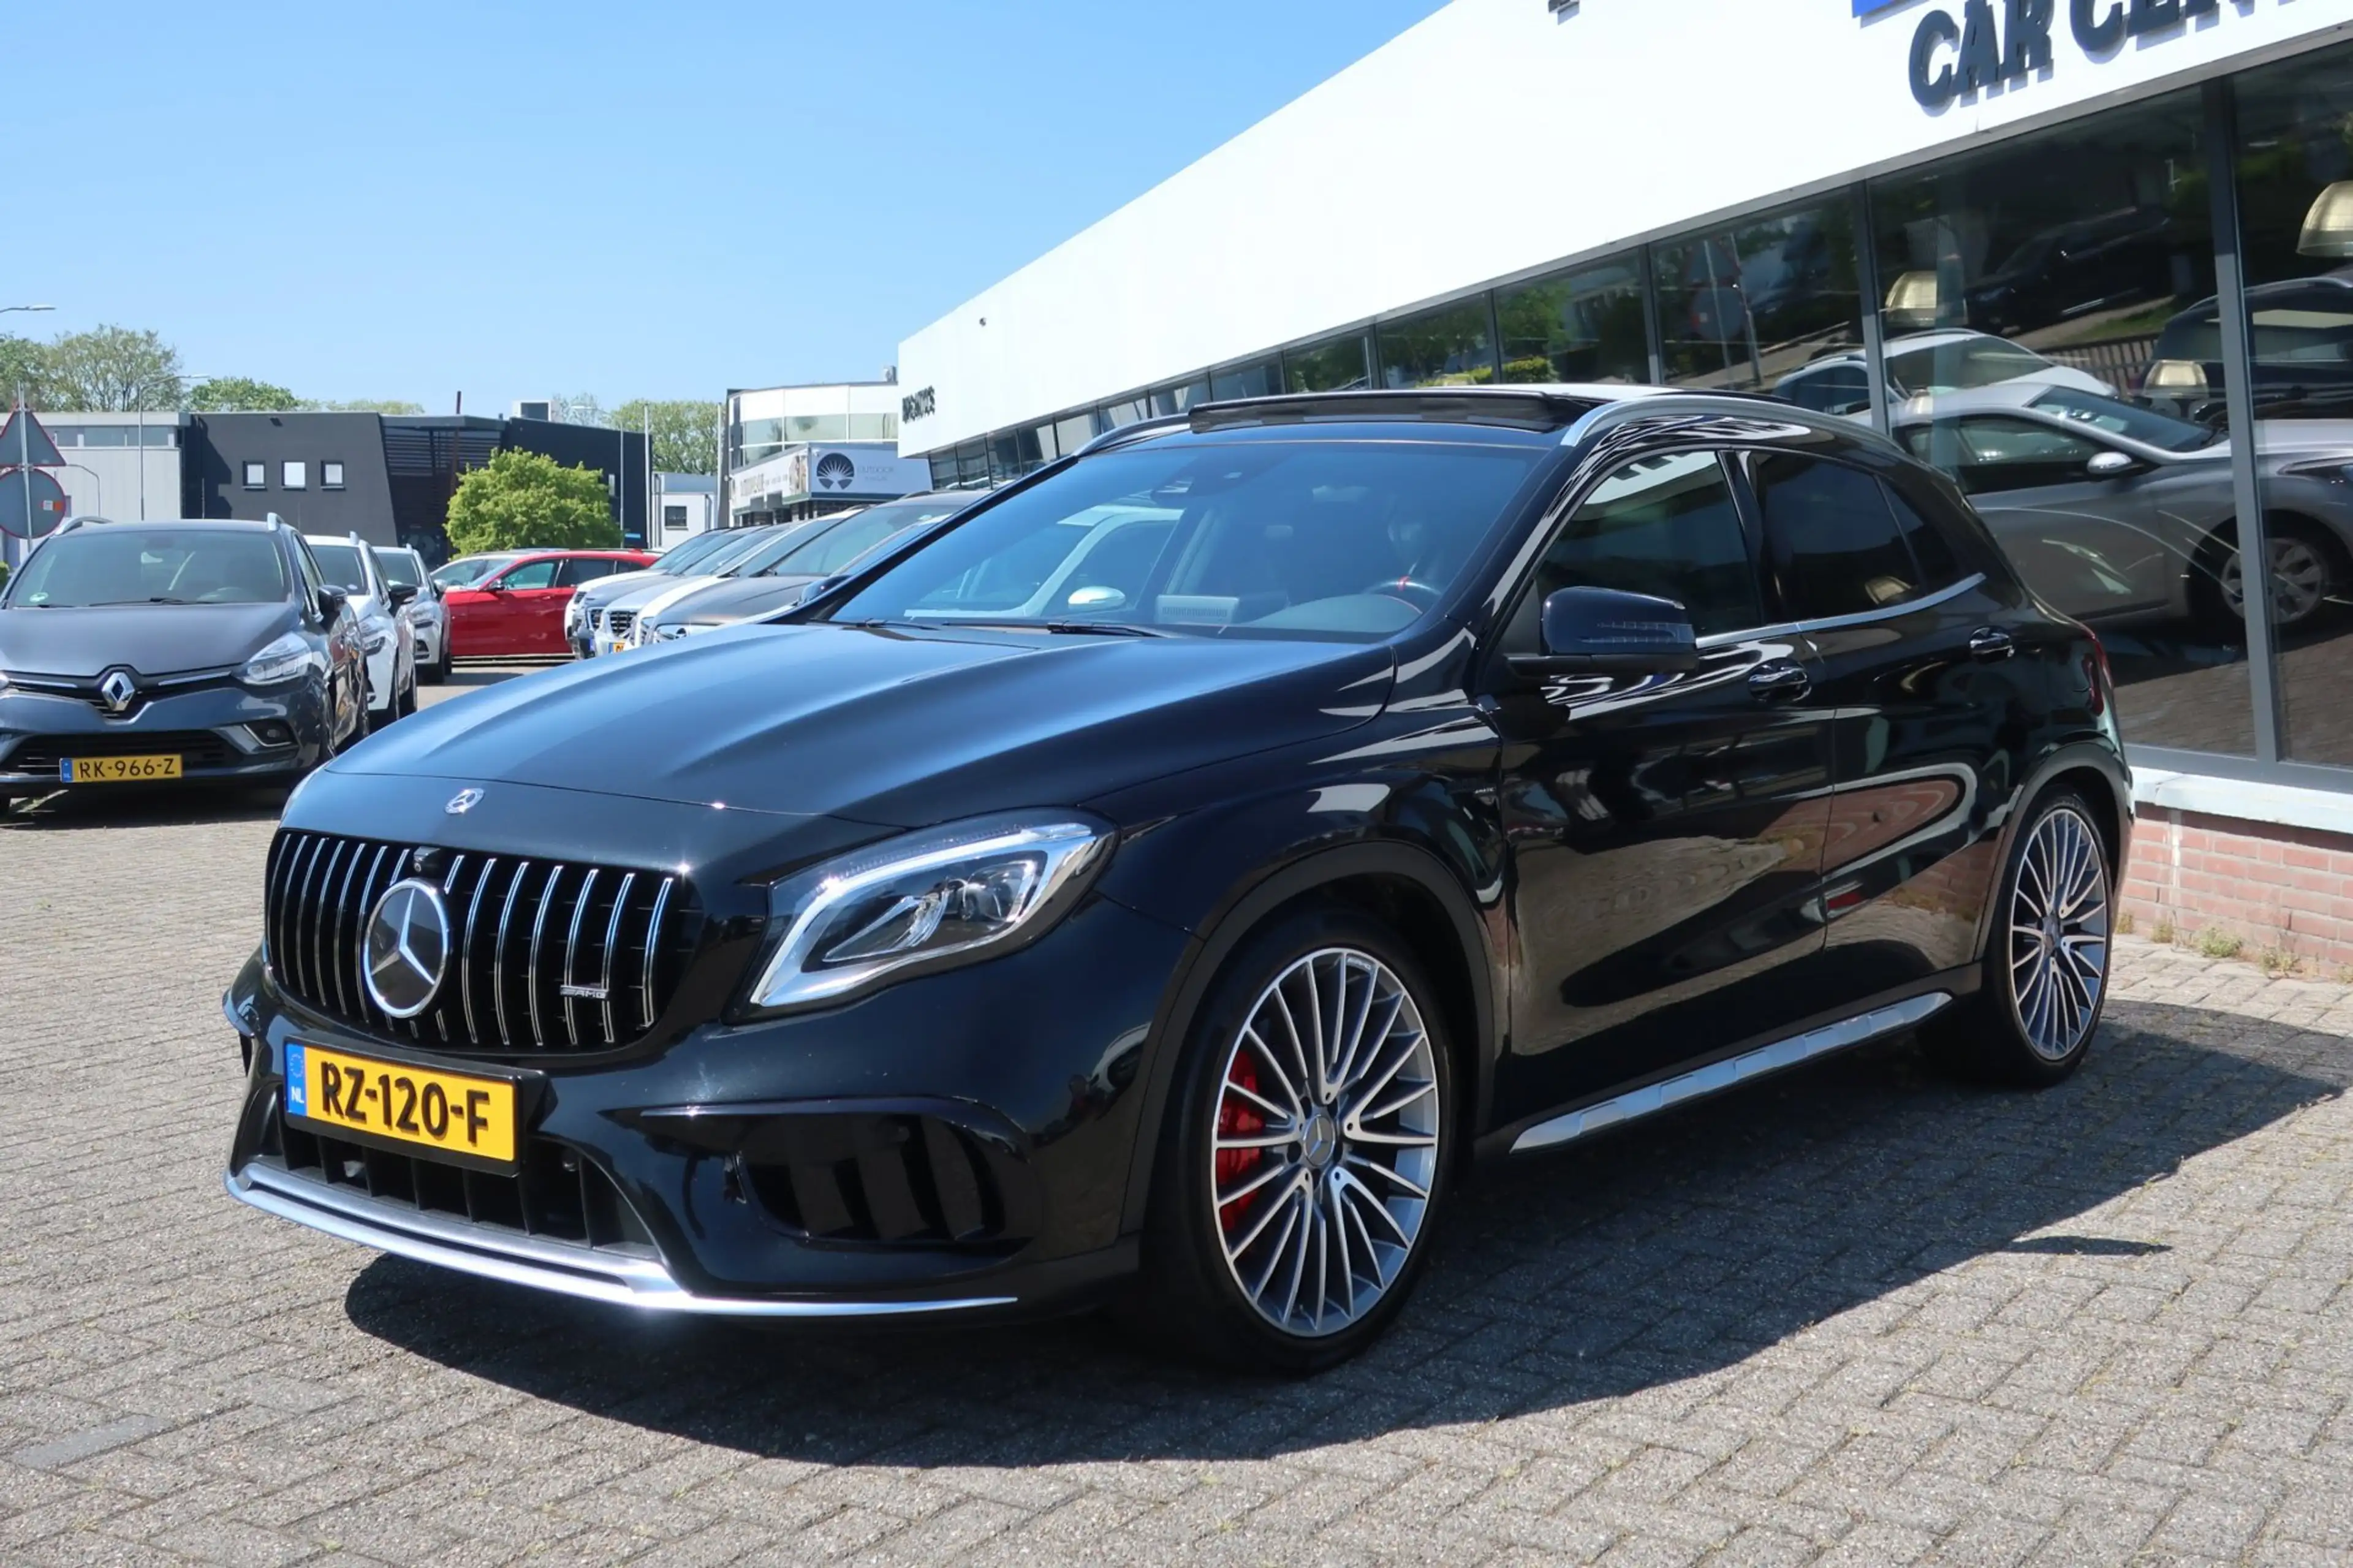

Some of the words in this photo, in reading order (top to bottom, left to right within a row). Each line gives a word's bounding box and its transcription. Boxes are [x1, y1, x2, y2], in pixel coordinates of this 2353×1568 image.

[1909, 0, 2053, 107] CAR
[79, 758, 175, 778] RK-966-Z
[291, 1087, 305, 1103] NL
[320, 1061, 490, 1146] RZ-120-F
